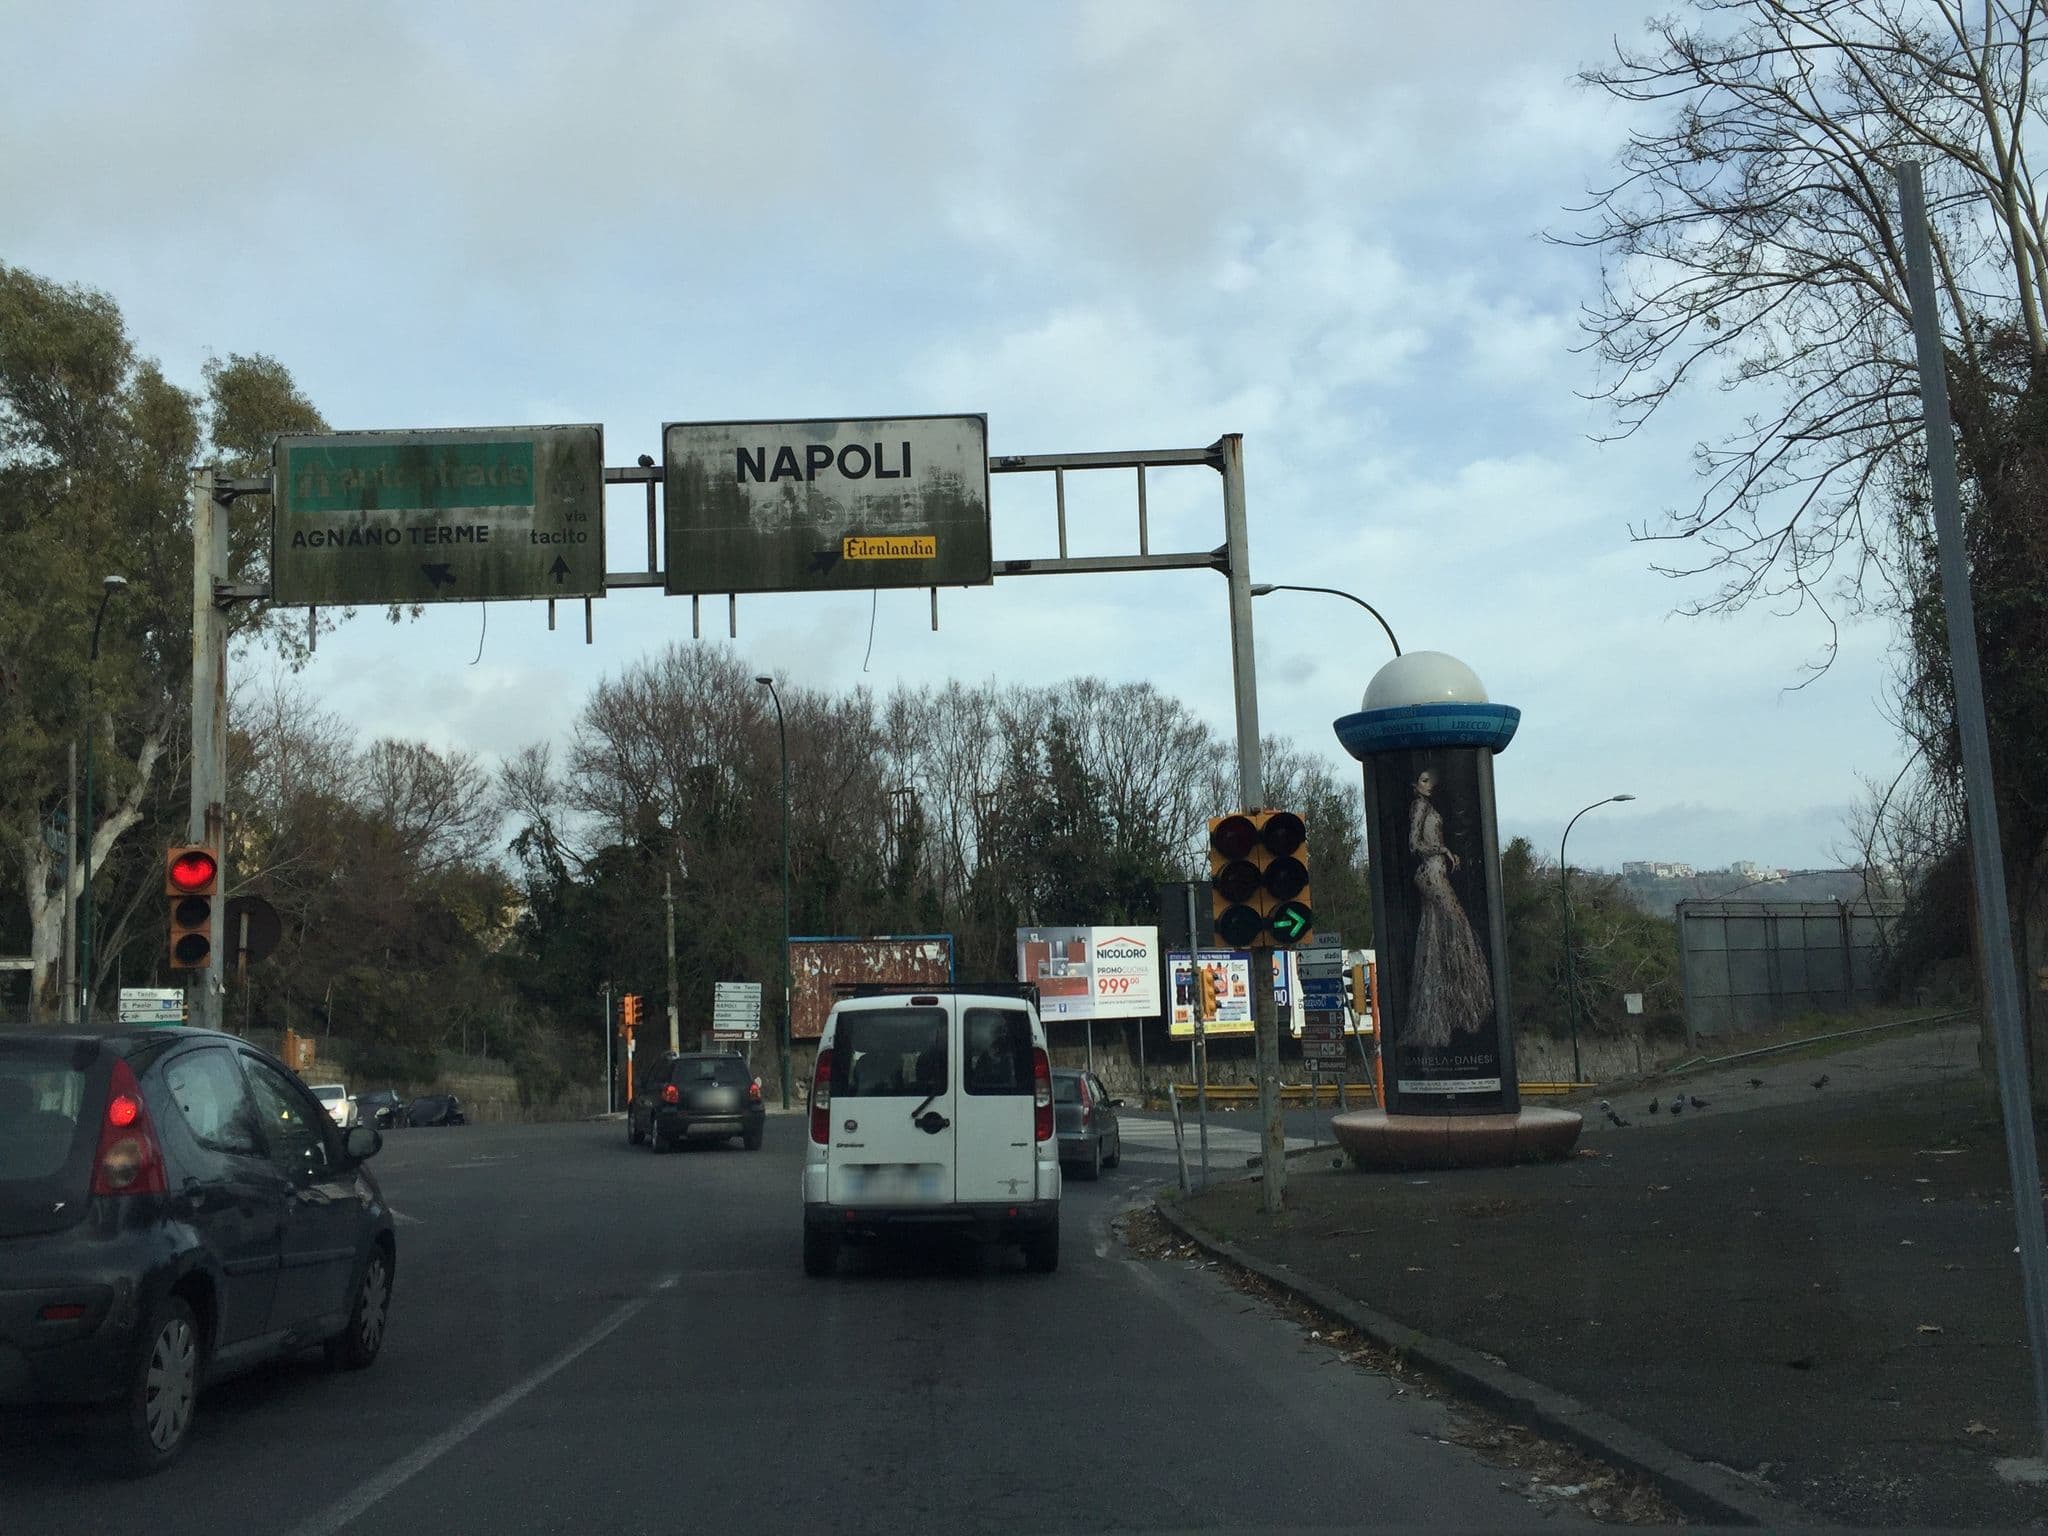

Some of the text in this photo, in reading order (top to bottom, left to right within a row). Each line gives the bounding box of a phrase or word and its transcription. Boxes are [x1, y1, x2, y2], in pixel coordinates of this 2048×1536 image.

[736, 441, 912, 483] NAPOLI
[565, 510, 587, 522] via
[292, 525, 489, 549] AGNANO TERME
[846, 538, 935, 559] Edenlandia
[1096, 948, 1147, 959] NICOLORO
[1454, 1053, 1494, 1065] DANESI
